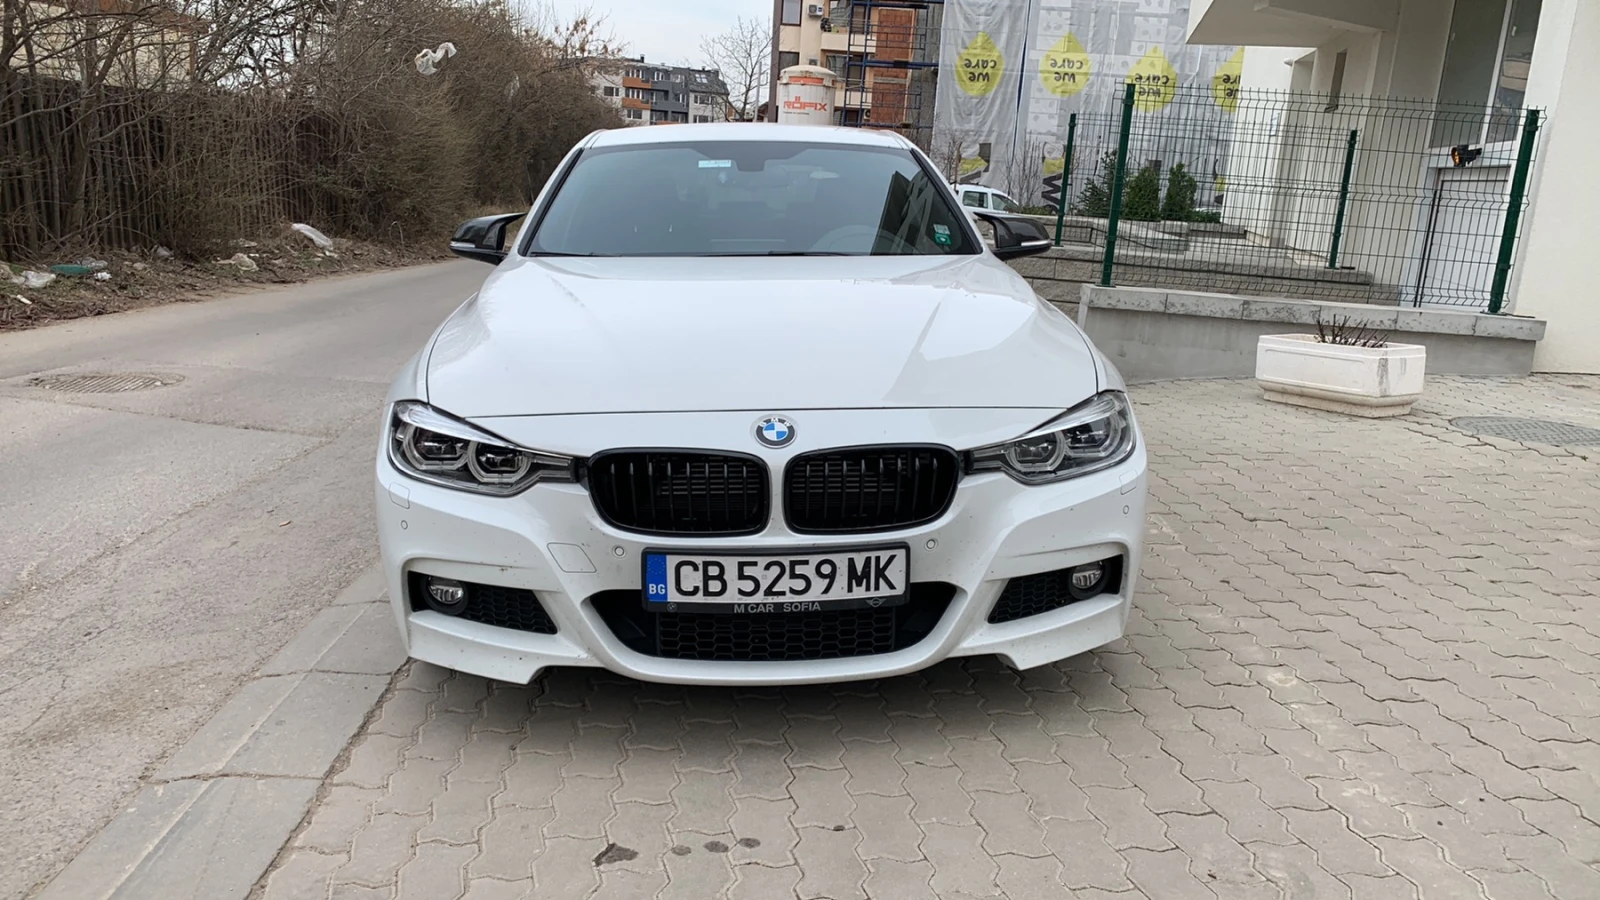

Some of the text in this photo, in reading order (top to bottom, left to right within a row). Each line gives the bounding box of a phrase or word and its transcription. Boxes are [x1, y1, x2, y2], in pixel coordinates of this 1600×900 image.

[963, 58, 998, 69] care
[1049, 57, 1084, 70] care
[968, 71, 990, 82] we
[1053, 71, 1076, 84] we
[1134, 73, 1170, 85] care
[783, 96, 828, 112] RÖFIX
[674, 554, 898, 598] CB 5259 MK
[648, 583, 666, 595] BG
[733, 601, 822, 614] M CAR SOFIA
